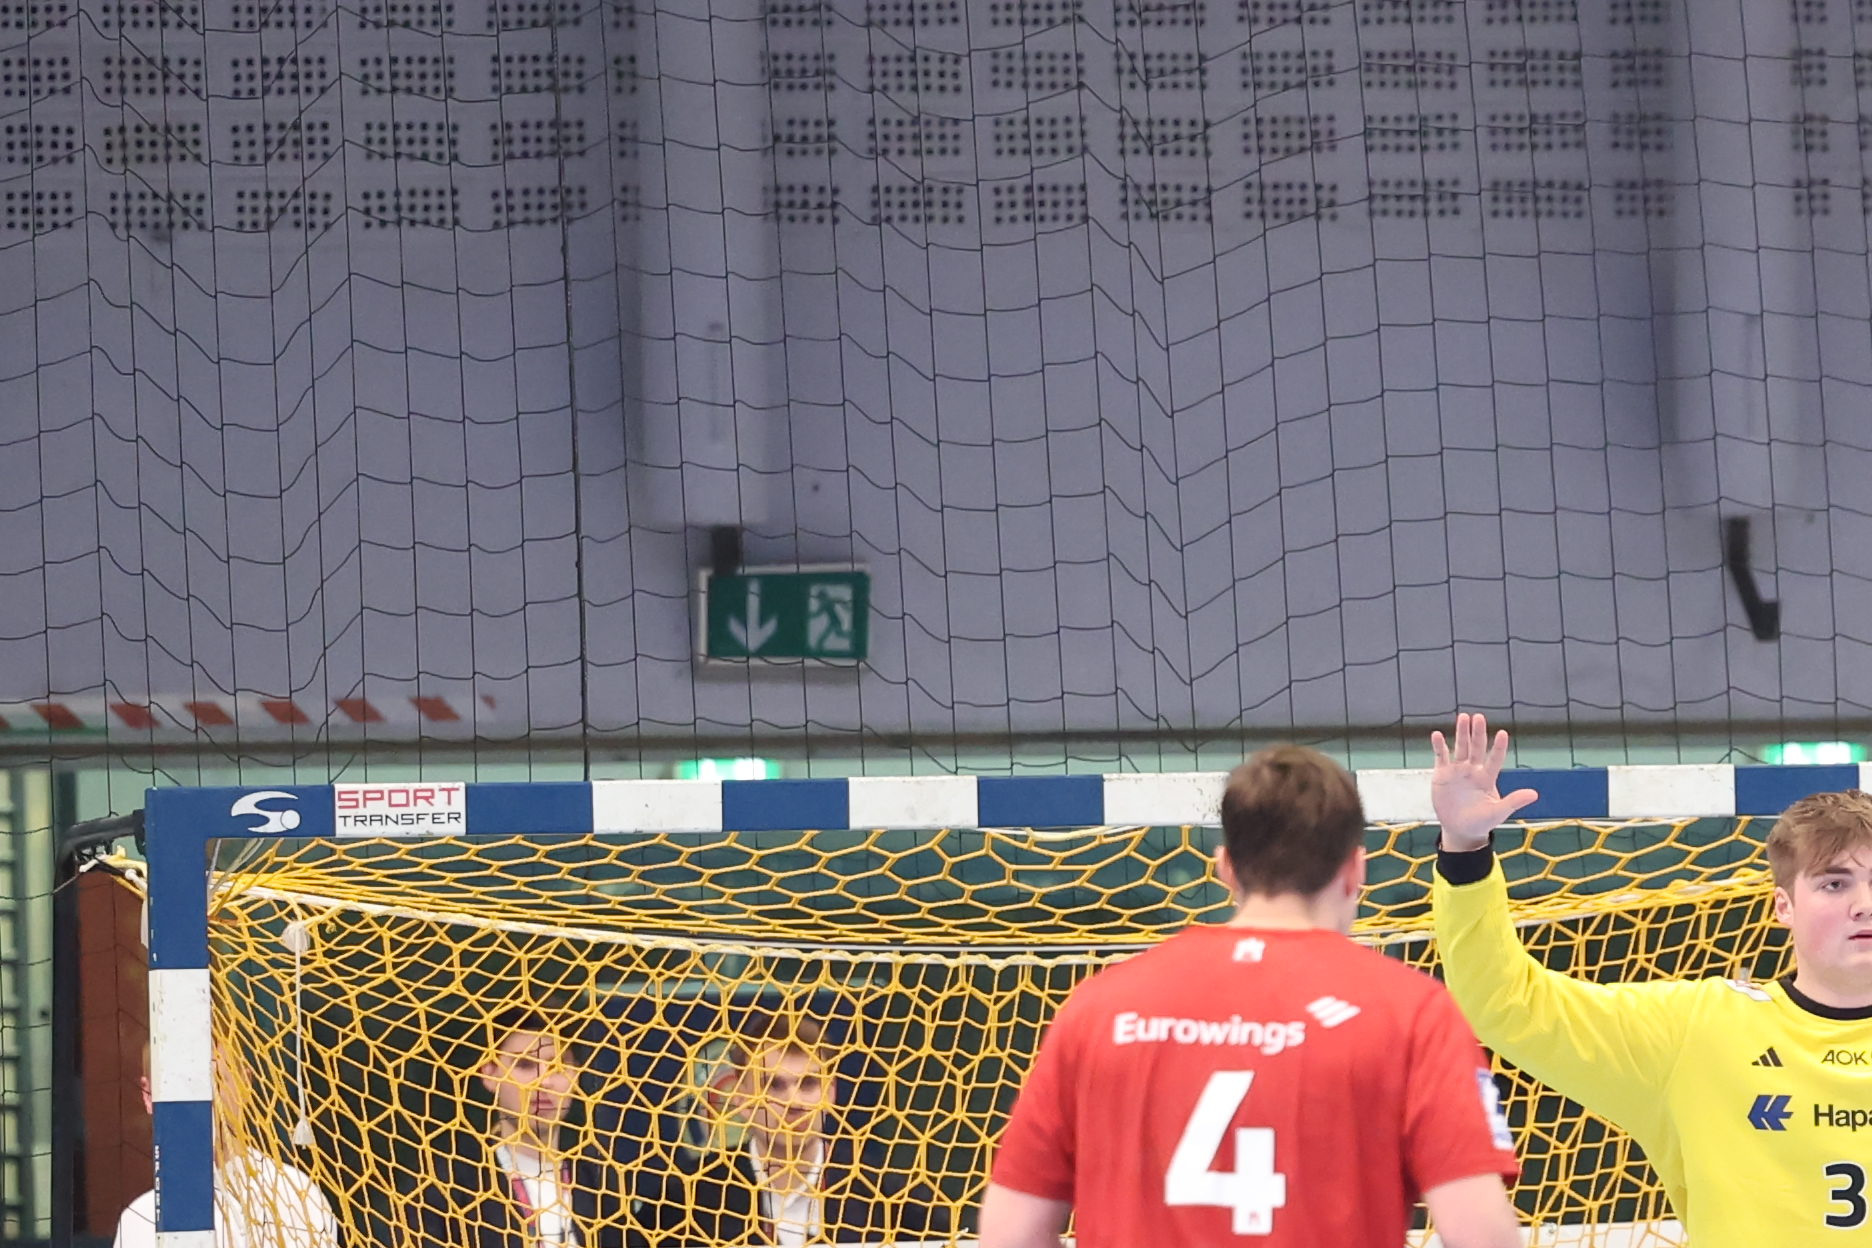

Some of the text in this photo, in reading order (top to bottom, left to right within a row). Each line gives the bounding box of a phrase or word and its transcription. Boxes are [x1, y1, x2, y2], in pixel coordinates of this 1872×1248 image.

[338, 788, 460, 809] SPORT
[338, 812, 462, 827] TRANSFER
[1113, 1012, 1307, 1056] Eurowings
[1821, 1050, 1868, 1066] AOK
[1164, 1070, 1287, 1235] 4
